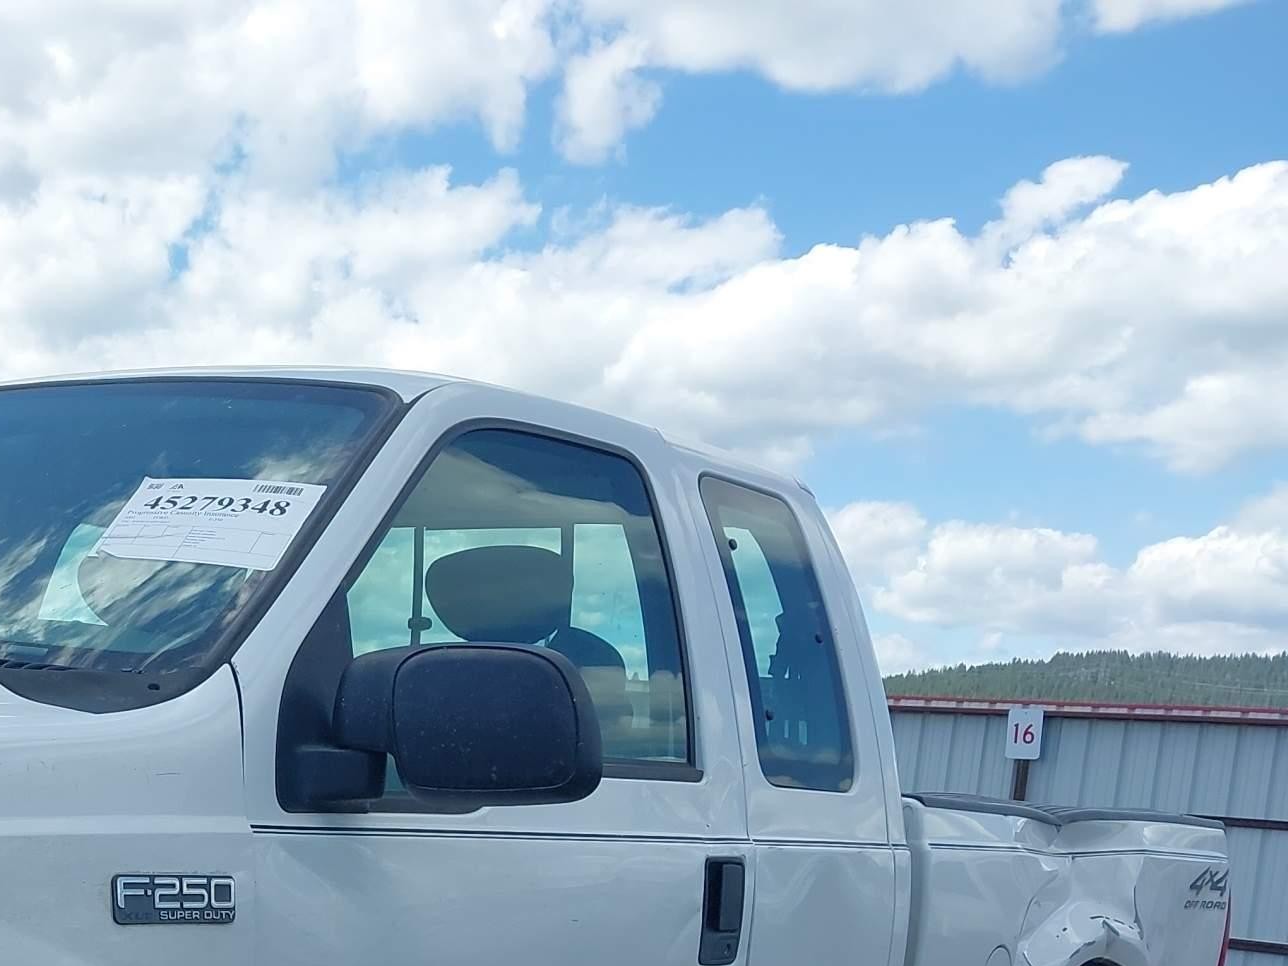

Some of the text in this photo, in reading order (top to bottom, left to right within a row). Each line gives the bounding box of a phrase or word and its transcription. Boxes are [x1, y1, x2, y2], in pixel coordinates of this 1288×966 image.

[144, 495, 291, 517] 45279348
[1013, 722, 1035, 745] 16
[1200, 900, 1227, 910] ROAD
[159, 910, 200, 920] SUPER
[203, 910, 235, 920] DUTY
